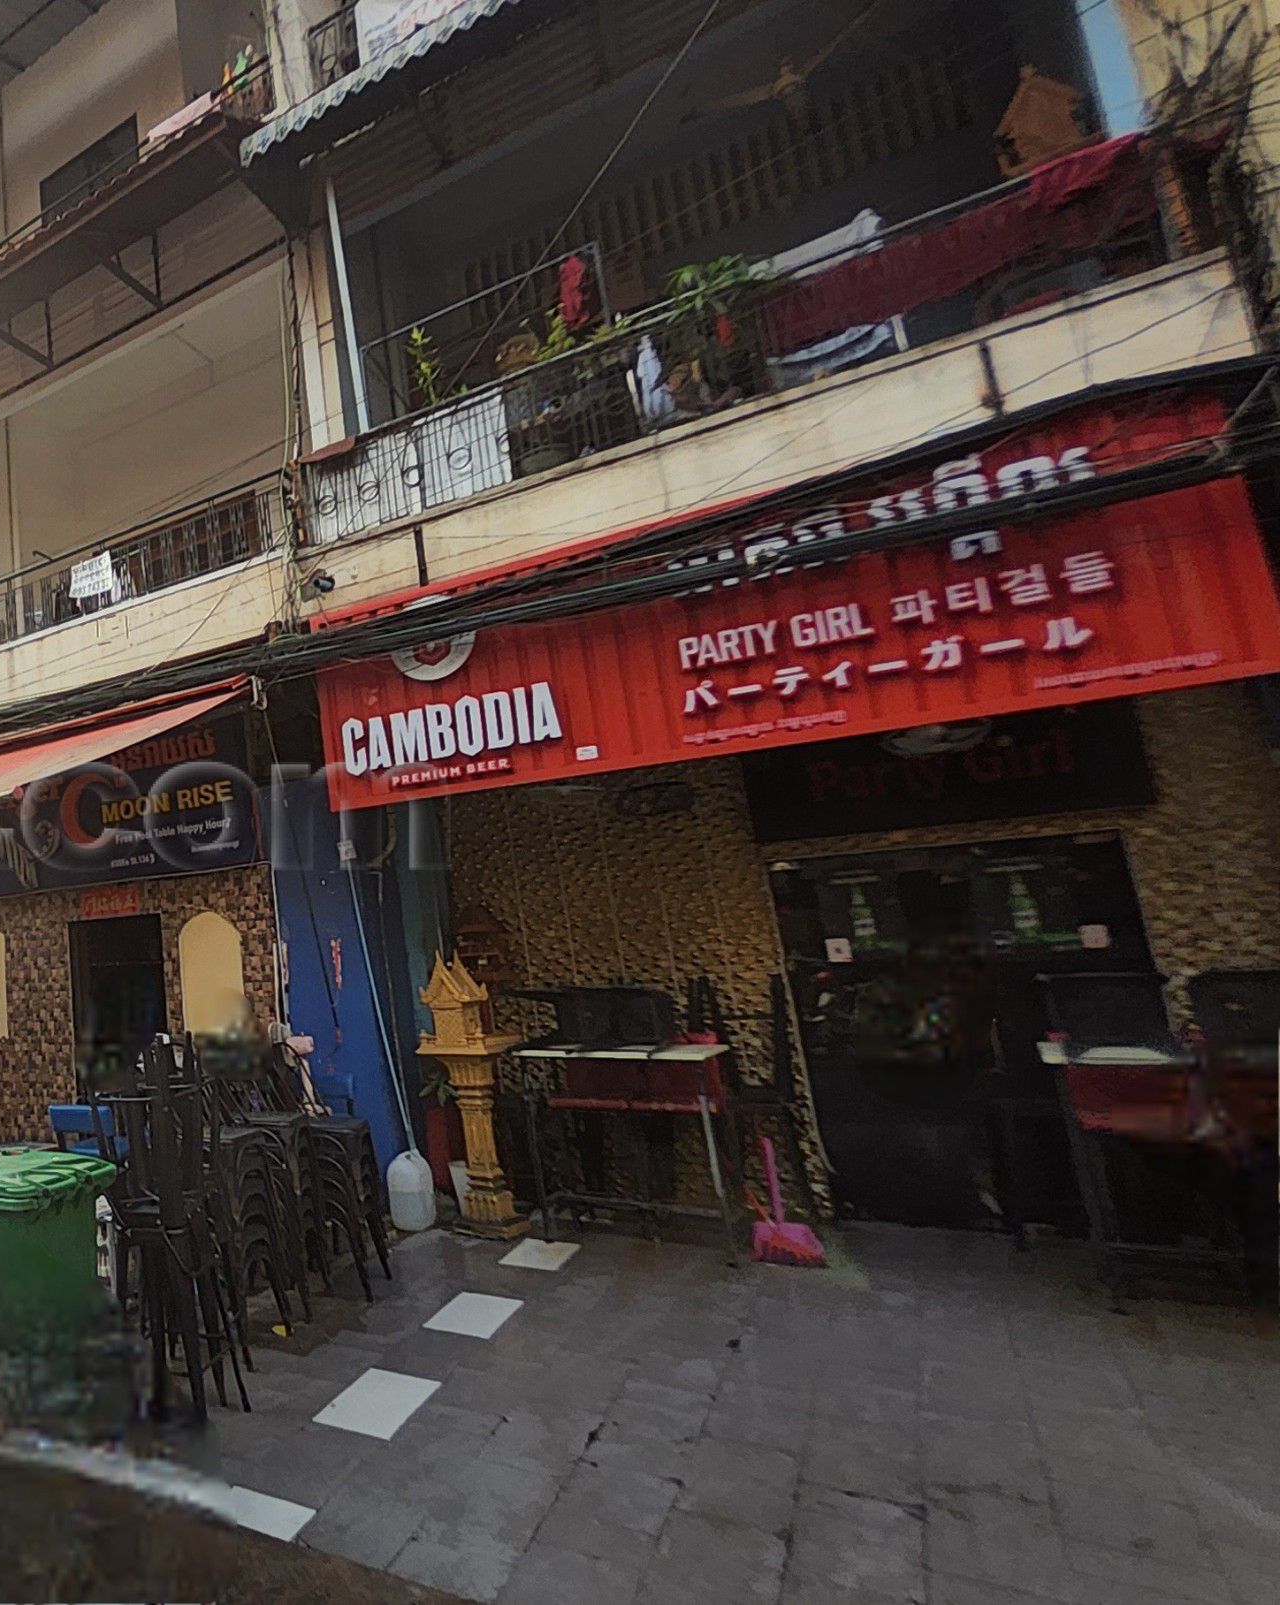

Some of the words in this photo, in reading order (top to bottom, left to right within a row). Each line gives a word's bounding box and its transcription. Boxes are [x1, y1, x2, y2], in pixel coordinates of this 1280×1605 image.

[678, 619, 777, 671] PARTY
[790, 602, 876, 648] GIRL
[683, 617, 1094, 714] パーティーガール
[341, 681, 562, 776] CAMBODIA
[391, 765, 462, 788] PREMIUM
[466, 758, 511, 774] BEER
[101, 792, 170, 824] MOON
[177, 780, 234, 810] RISE
[154, 826, 176, 838] Table
[177, 822, 204, 836] Happy
